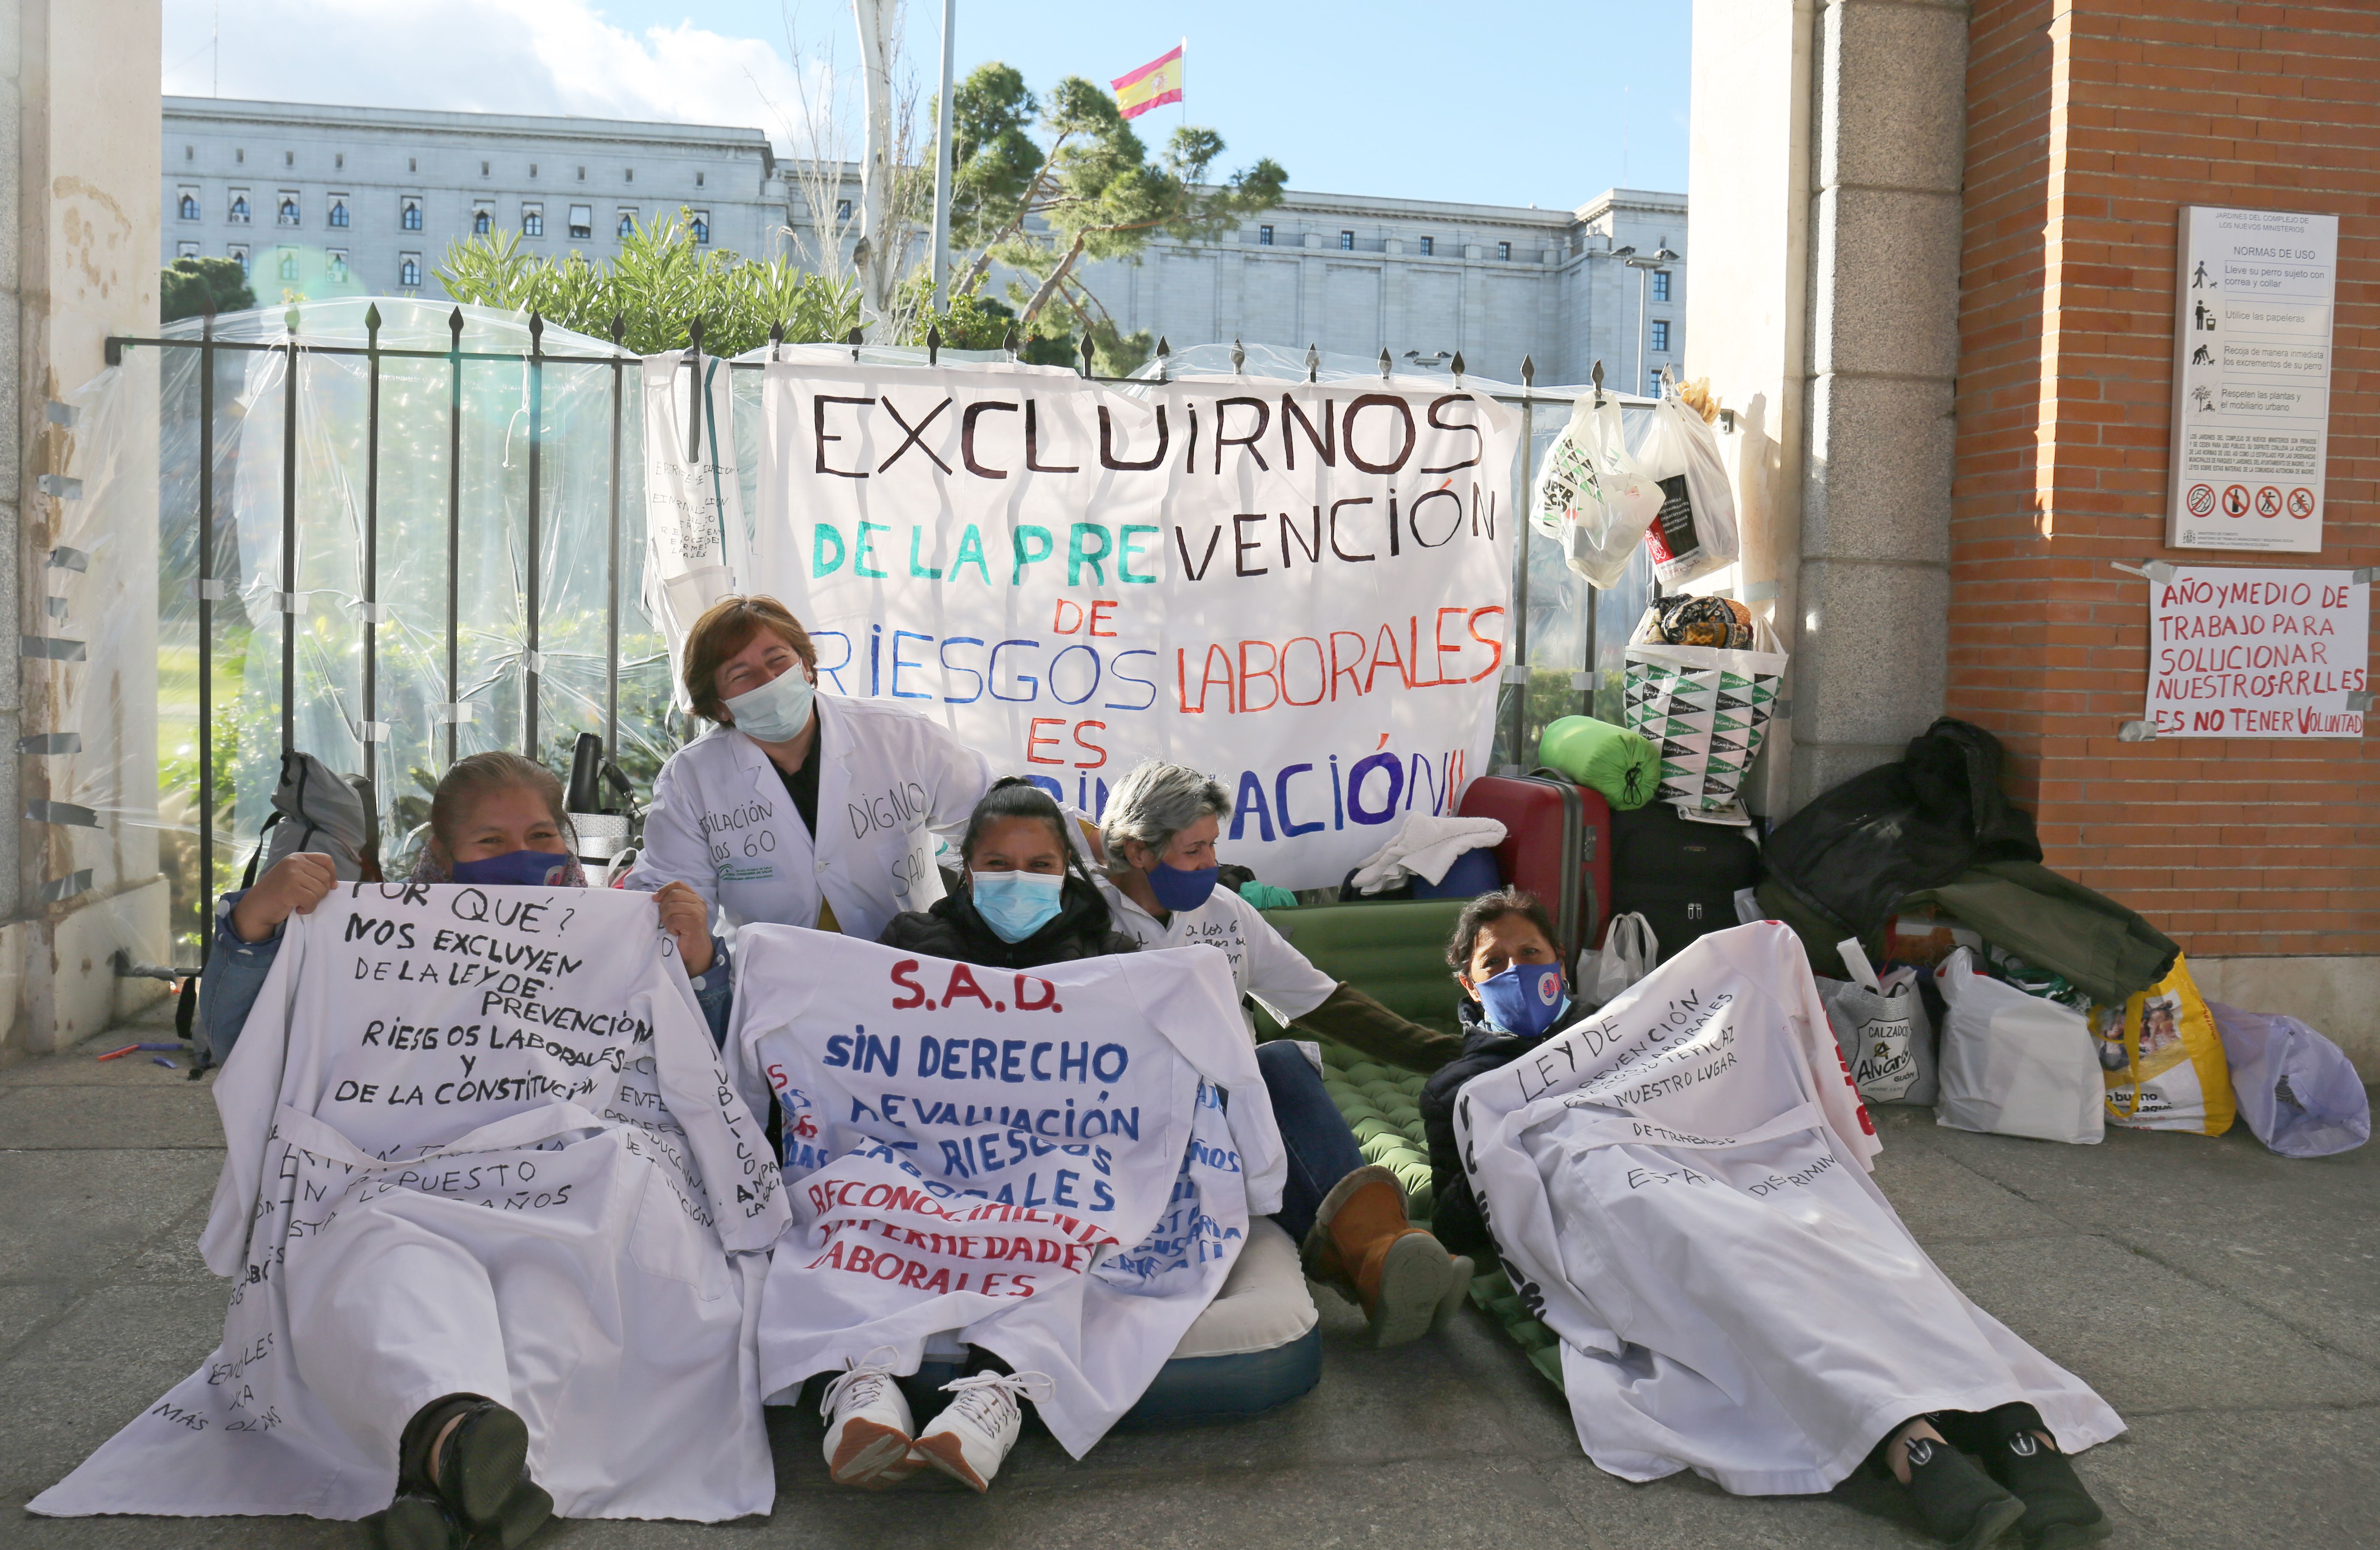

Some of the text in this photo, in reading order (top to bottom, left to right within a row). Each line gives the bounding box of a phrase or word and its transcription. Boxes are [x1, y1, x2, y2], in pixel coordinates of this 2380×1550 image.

[2263, 225, 2305, 233] MINISTERIOS
[2234, 246, 2315, 259] NORMAS DE USO
[2225, 265, 2247, 274] Lleve
[2284, 270, 2308, 279] sujeto
[2253, 280, 2257, 288] y
[2226, 310, 2250, 319] Utilice
[2266, 314, 2305, 322] papeleras
[2224, 346, 2249, 356] Recoja
[2290, 349, 2323, 359] inmediata
[2224, 357, 2234, 366] los
[2236, 359, 2281, 367] excrementos
[2222, 389, 2301, 402] Respeten las plantas y
[2230, 401, 2263, 410] mobiliario
[2266, 403, 2289, 411] urbano
[814, 392, 1483, 479] EXCLUIRNOS
[812, 520, 891, 579] DE
[910, 523, 993, 586] LA
[2161, 577, 2213, 608] AÑO
[2230, 582, 2311, 604] MEDIO
[2322, 586, 2350, 608] DE
[1054, 599, 1118, 636] DE
[2160, 614, 2335, 642] TRABAJO PARA
[1177, 605, 1505, 714] LABORALES
[2160, 642, 2328, 676] SOLUCIONAR
[2156, 706, 2362, 734] ES NO TENER VOLUNTAD
[1028, 718, 1107, 768] ES
[743, 830, 775, 857] 60
[1186, 925, 1198, 936] a
[1202, 922, 1223, 936] los
[345, 913, 583, 977] NOS EXCLUYEN
[355, 957, 546, 998] DE LA LEY DE
[890, 958, 1064, 1013] S.A.D.
[481, 991, 654, 1046] PREVENCIÓN
[362, 1017, 481, 1051] RIESGOS
[490, 1025, 625, 1074] LABORALES
[822, 1024, 1130, 1084] SIN DERECHO
[1515, 1040, 1576, 1103] LEY
[1582, 1015, 1623, 1058] DE
[460, 1054, 476, 1078] Y
[1613, 1072, 1692, 1107] NUESTRO
[1697, 1051, 1737, 1083] LUGAR
[335, 1080, 379, 1103] DE
[388, 1084, 424, 1106] LA
[2115, 1092, 2158, 1102] buno
[880, 1090, 1139, 1142] EVALUACIÓN
[1633, 1123, 1653, 1136] DE
[399, 1161, 536, 1193] PUESTO
[803, 1240, 1037, 1298] LABORALES
